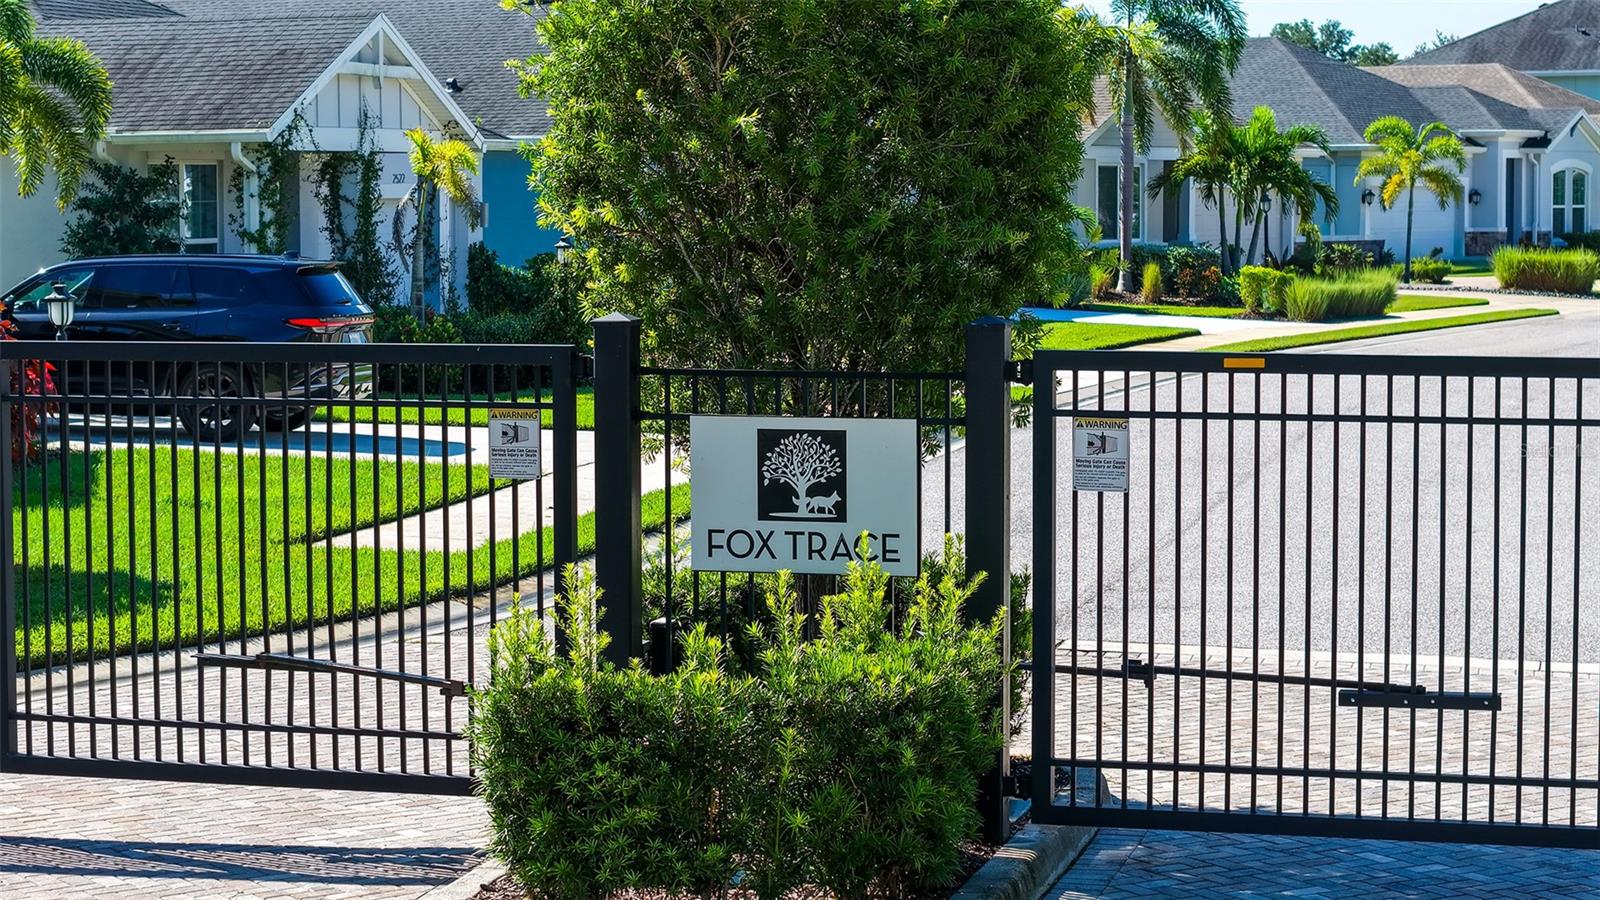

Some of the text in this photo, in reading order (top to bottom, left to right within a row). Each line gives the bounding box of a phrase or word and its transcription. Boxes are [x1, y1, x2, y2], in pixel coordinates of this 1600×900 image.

[499, 411, 538, 419] WARNING
[1085, 420, 1128, 430] WARNING
[707, 529, 900, 563] FOX TRACE
